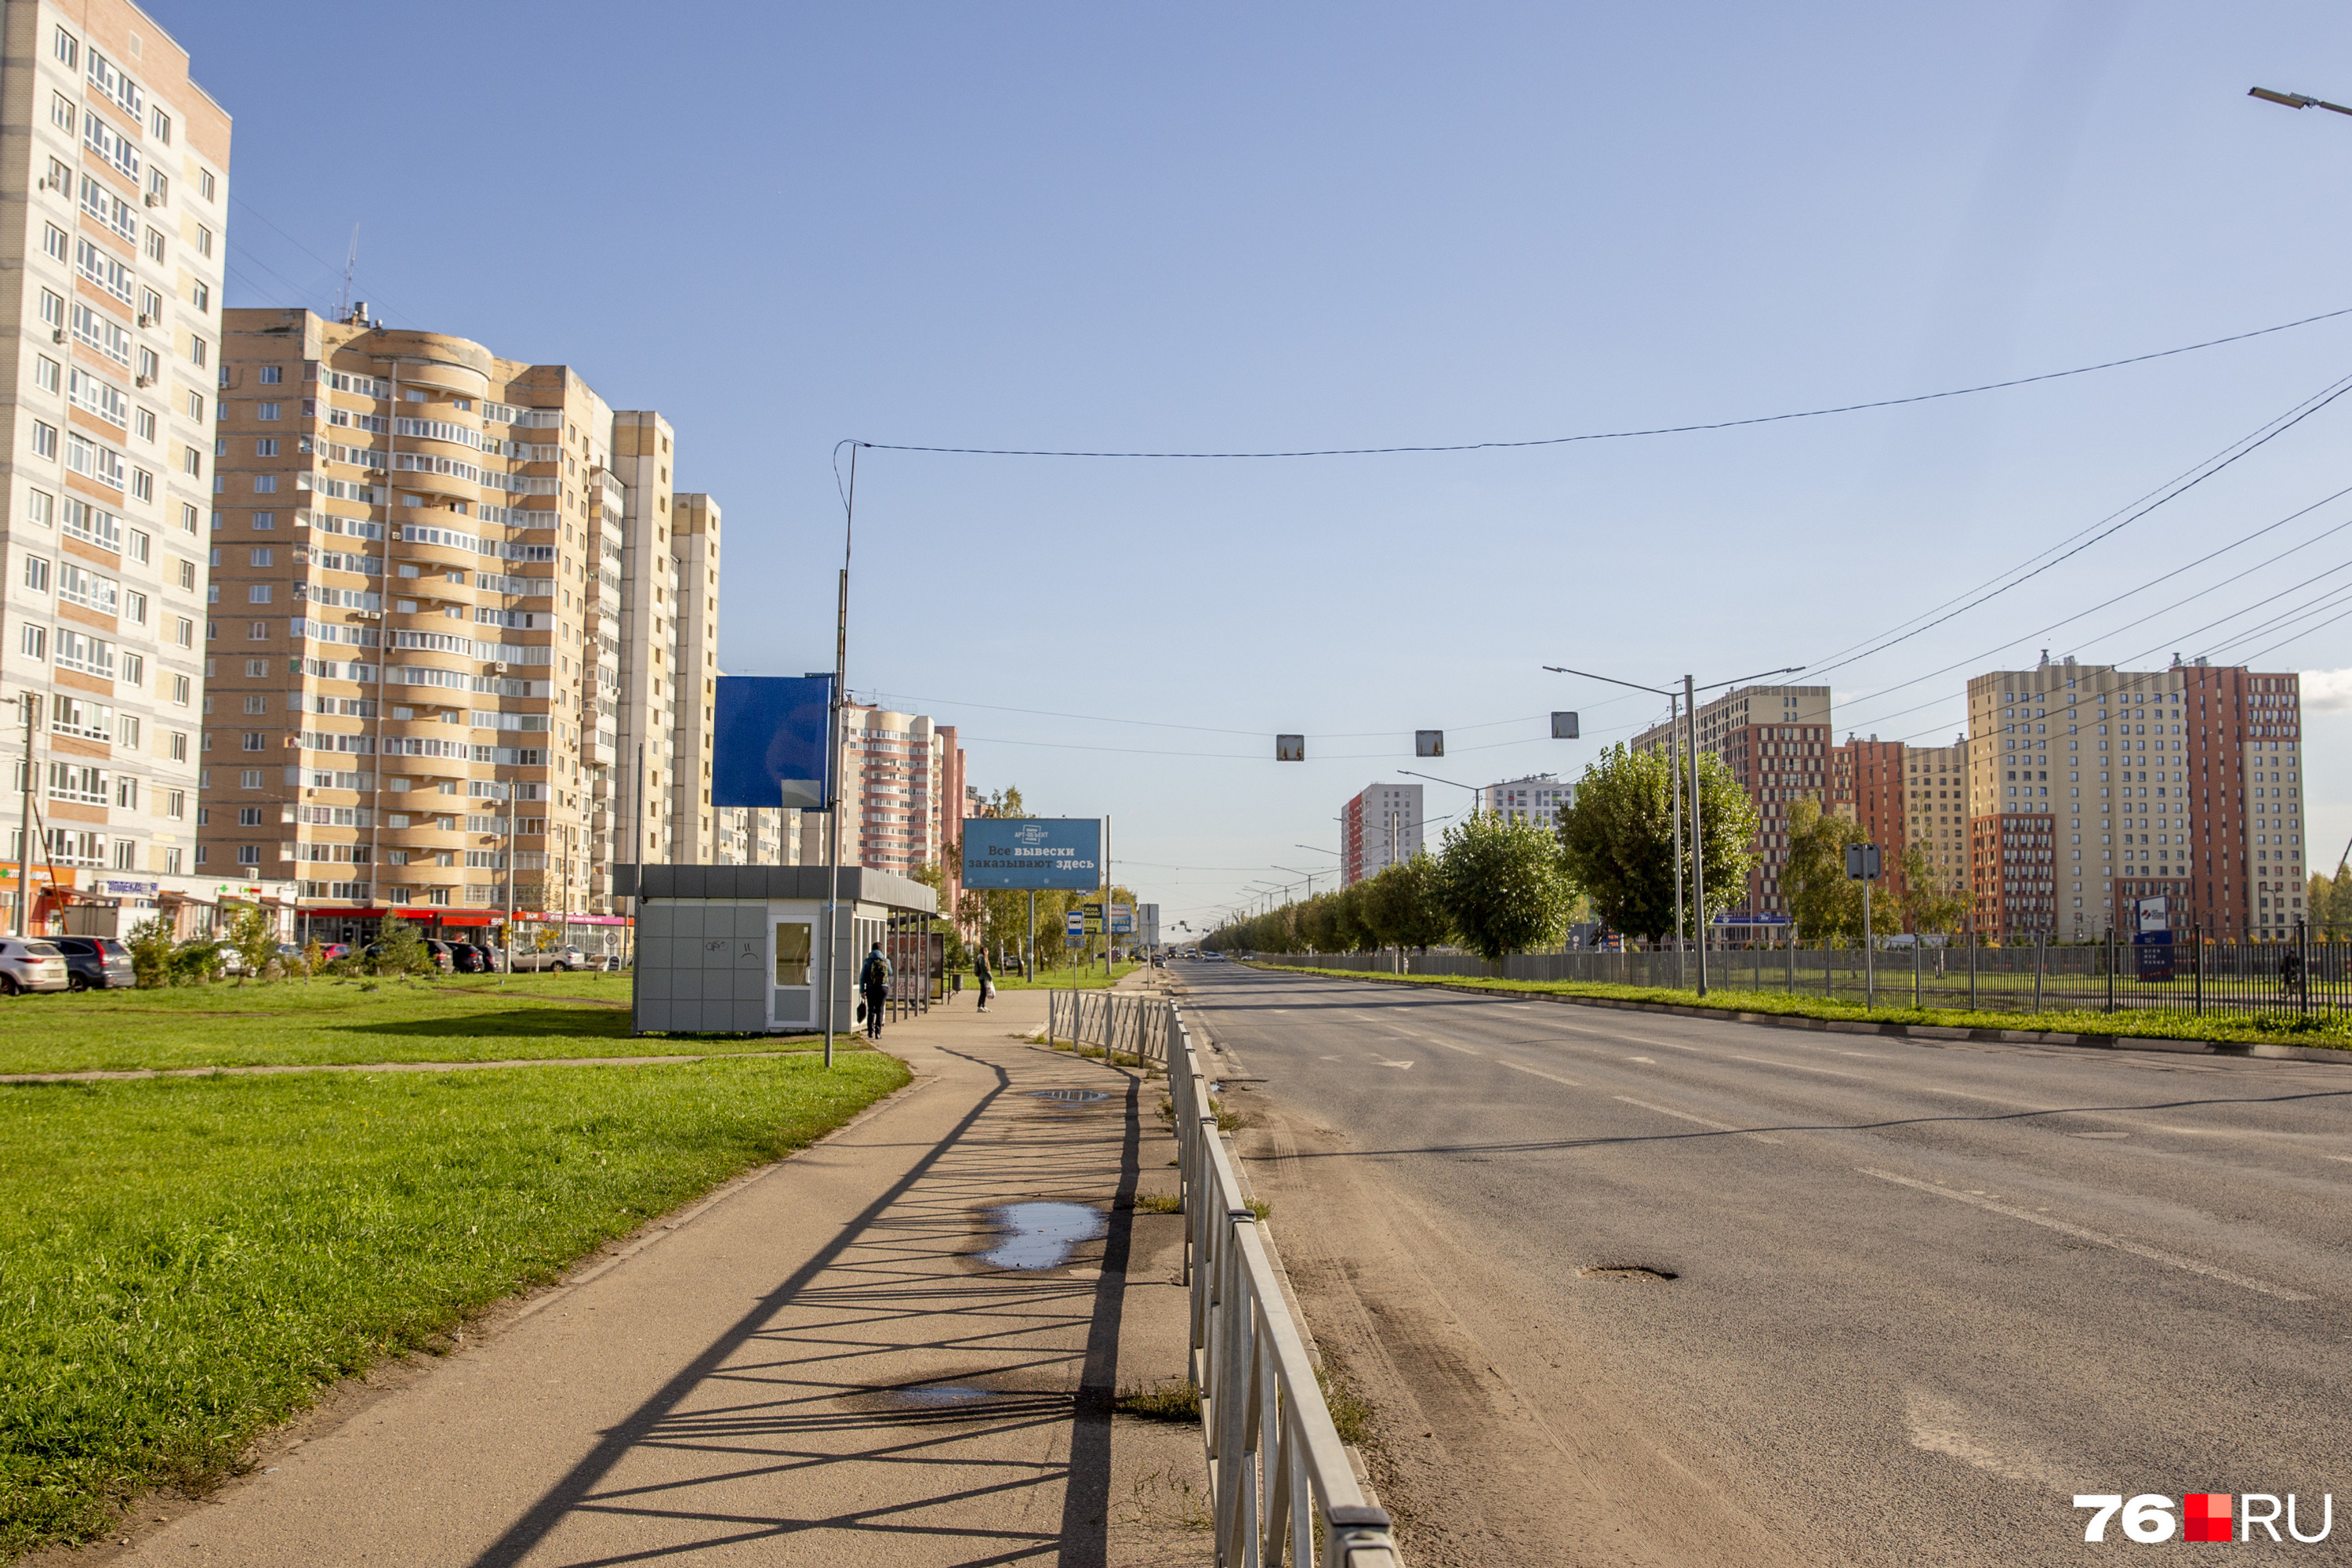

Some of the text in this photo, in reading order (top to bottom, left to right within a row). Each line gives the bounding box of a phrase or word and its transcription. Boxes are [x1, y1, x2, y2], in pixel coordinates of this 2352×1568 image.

[989, 845, 1075, 857] Все вывески
[968, 859, 1094, 871] заказывают здесь
[108, 880, 142, 893] АПТЕКА
